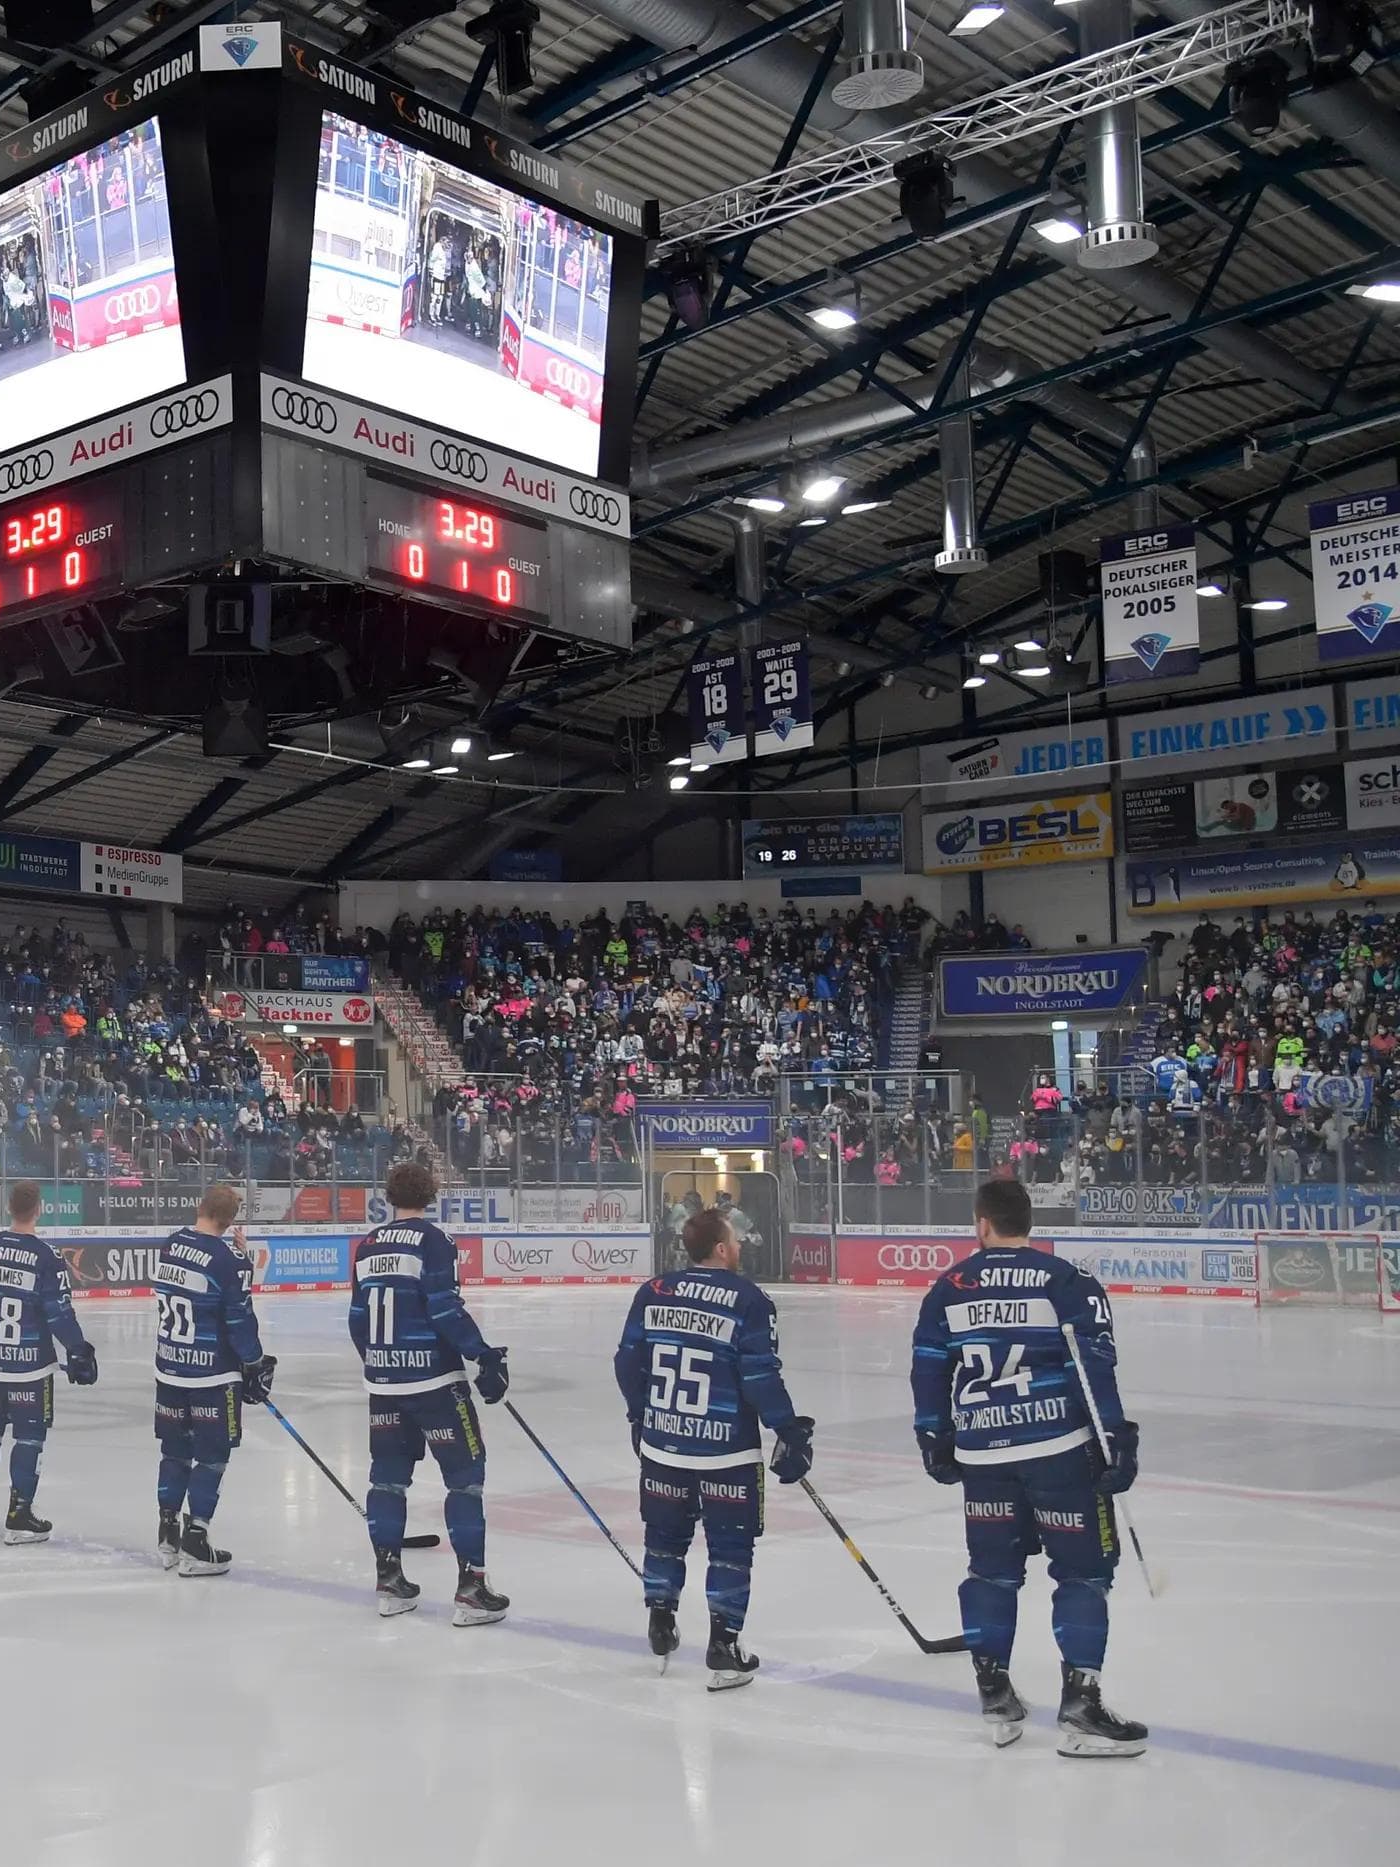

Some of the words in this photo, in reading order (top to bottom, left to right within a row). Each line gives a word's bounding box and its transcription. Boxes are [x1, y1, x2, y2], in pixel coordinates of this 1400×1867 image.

[226, 25, 253, 34] ERC
[133, 51, 193, 101] SATURN
[318, 60, 375, 104] SATURN
[33, 107, 88, 154] SATURN
[418, 106, 471, 149] SATURN
[510, 149, 559, 190] SATURN
[595, 191, 642, 227] SATURN
[69, 422, 132, 466] Audi
[353, 418, 415, 458] Audi
[502, 467, 556, 503] Audi
[1337, 496, 1387, 517] ERC
[75, 524, 114, 549] GUEST
[378, 518, 411, 538] HOME
[1124, 533, 1168, 553] ERC
[27, 566, 35, 596] 1
[65, 551, 81, 586] 0
[409, 544, 424, 579] 0
[461, 561, 468, 590] 1
[496, 569, 511, 603] 0
[508, 557, 541, 577] GUEST
[1108, 559, 1188, 583] DEUTSCHER
[1337, 562, 1399, 590] 2014
[1104, 574, 1195, 600] POKALSIEGER
[1123, 595, 1176, 619] 2005
[765, 657, 794, 673] WAITE
[705, 672, 722, 685] AST
[764, 669, 798, 704] 29
[703, 684, 728, 716] 18
[1014, 736, 1105, 776] JEDER
[1131, 711, 1272, 761] EINKAUF
[958, 758, 988, 776] SATURN
[978, 810, 1100, 846] BESL
[19, 853, 69, 867] STADTWERKE
[107, 845, 162, 867] espresso
[19, 862, 69, 877] INGOLSTADT
[106, 865, 169, 887] MedienGruppe
[304, 977, 356, 988] PANTHER!
[976, 969, 1119, 998] NORDBRÄU
[256, 995, 334, 1008] BACKHAUS
[1015, 999, 1084, 1010] INGOLSTADT
[258, 1006, 334, 1022] Hackner
[650, 1116, 756, 1137] NORDBRÄU
[99, 1196, 138, 1208] HELLO!
[167, 1196, 179, 1208] IS
[1086, 1186, 1175, 1215] BLOCK
[375, 1229, 424, 1246] SATURN
[169, 1242, 213, 1268] SATURN
[275, 1247, 338, 1265] BODYCHECK
[791, 1244, 828, 1268] Audi
[1133, 1247, 1187, 1258] Personal
[158, 1265, 187, 1286] QUAAS
[368, 1256, 401, 1275] AUBRY
[979, 1267, 1052, 1288] SATURN
[1231, 1266, 1254, 1278] JOB
[674, 1281, 739, 1309] SATURN
[157, 1293, 195, 1344] 20
[367, 1287, 395, 1346] 11
[650, 1307, 725, 1338] WARSOFSKY
[968, 1302, 1028, 1326] DEFAZIO
[650, 1343, 714, 1416] 55
[959, 1344, 1033, 1405] 24
[971, 1397, 1067, 1430] INGOLSTADT
[654, 1411, 732, 1442] INGOLSTADT
[644, 1478, 689, 1499] CINQUE
[700, 1480, 748, 1500] CINQUE
[966, 1501, 1015, 1518] CINQUE
